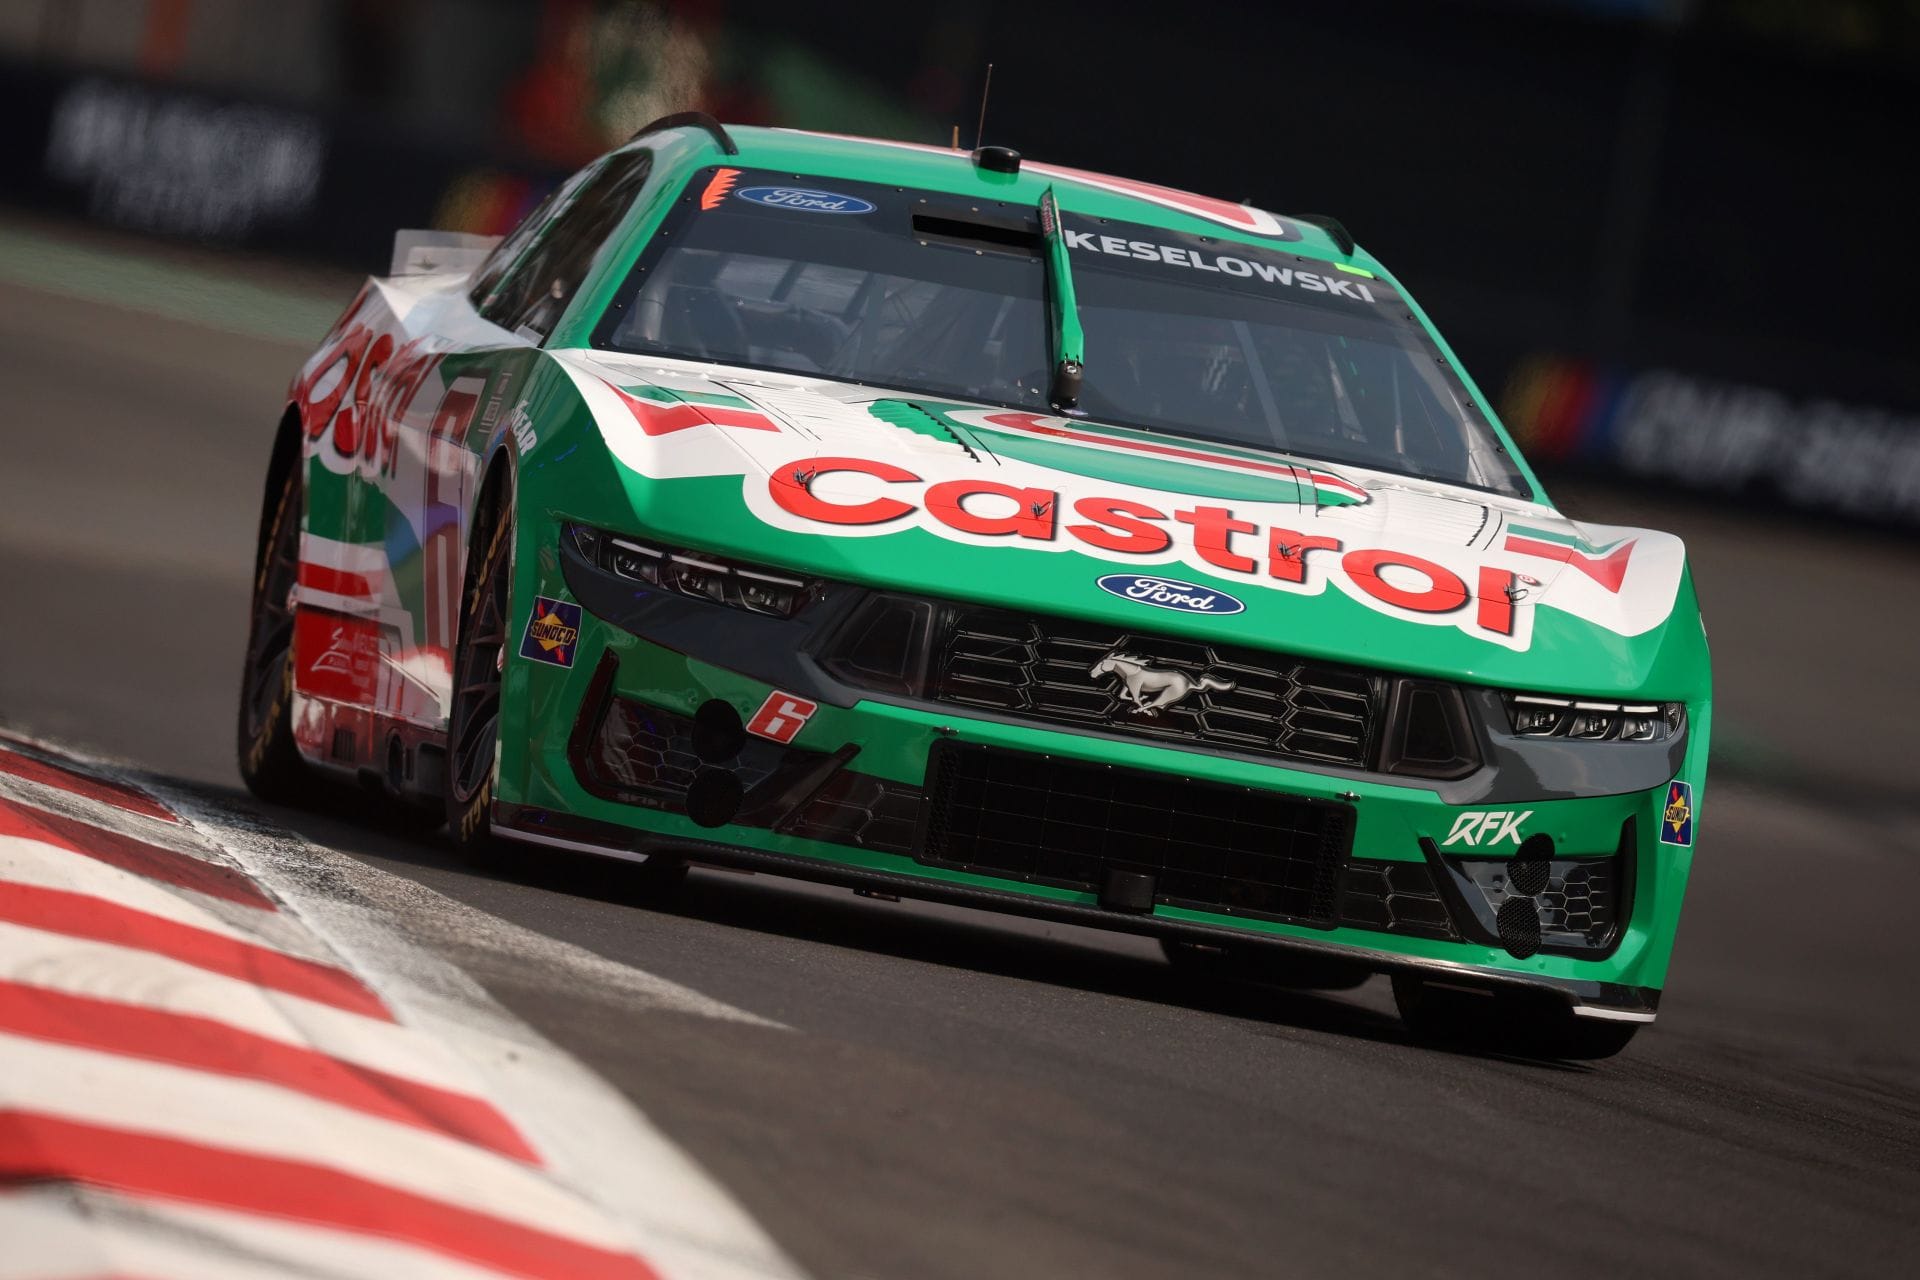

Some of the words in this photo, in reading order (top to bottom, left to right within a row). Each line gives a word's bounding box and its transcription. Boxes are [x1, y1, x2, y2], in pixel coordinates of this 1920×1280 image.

[763, 188, 848, 211] Ford
[1064, 230, 1375, 302] KESELOWSKI
[769, 456, 1514, 636] Castrol
[1126, 578, 1216, 610] Ford
[530, 620, 577, 646] SUNOCO
[746, 690, 818, 744] 6
[1441, 810, 1535, 846] RFK
